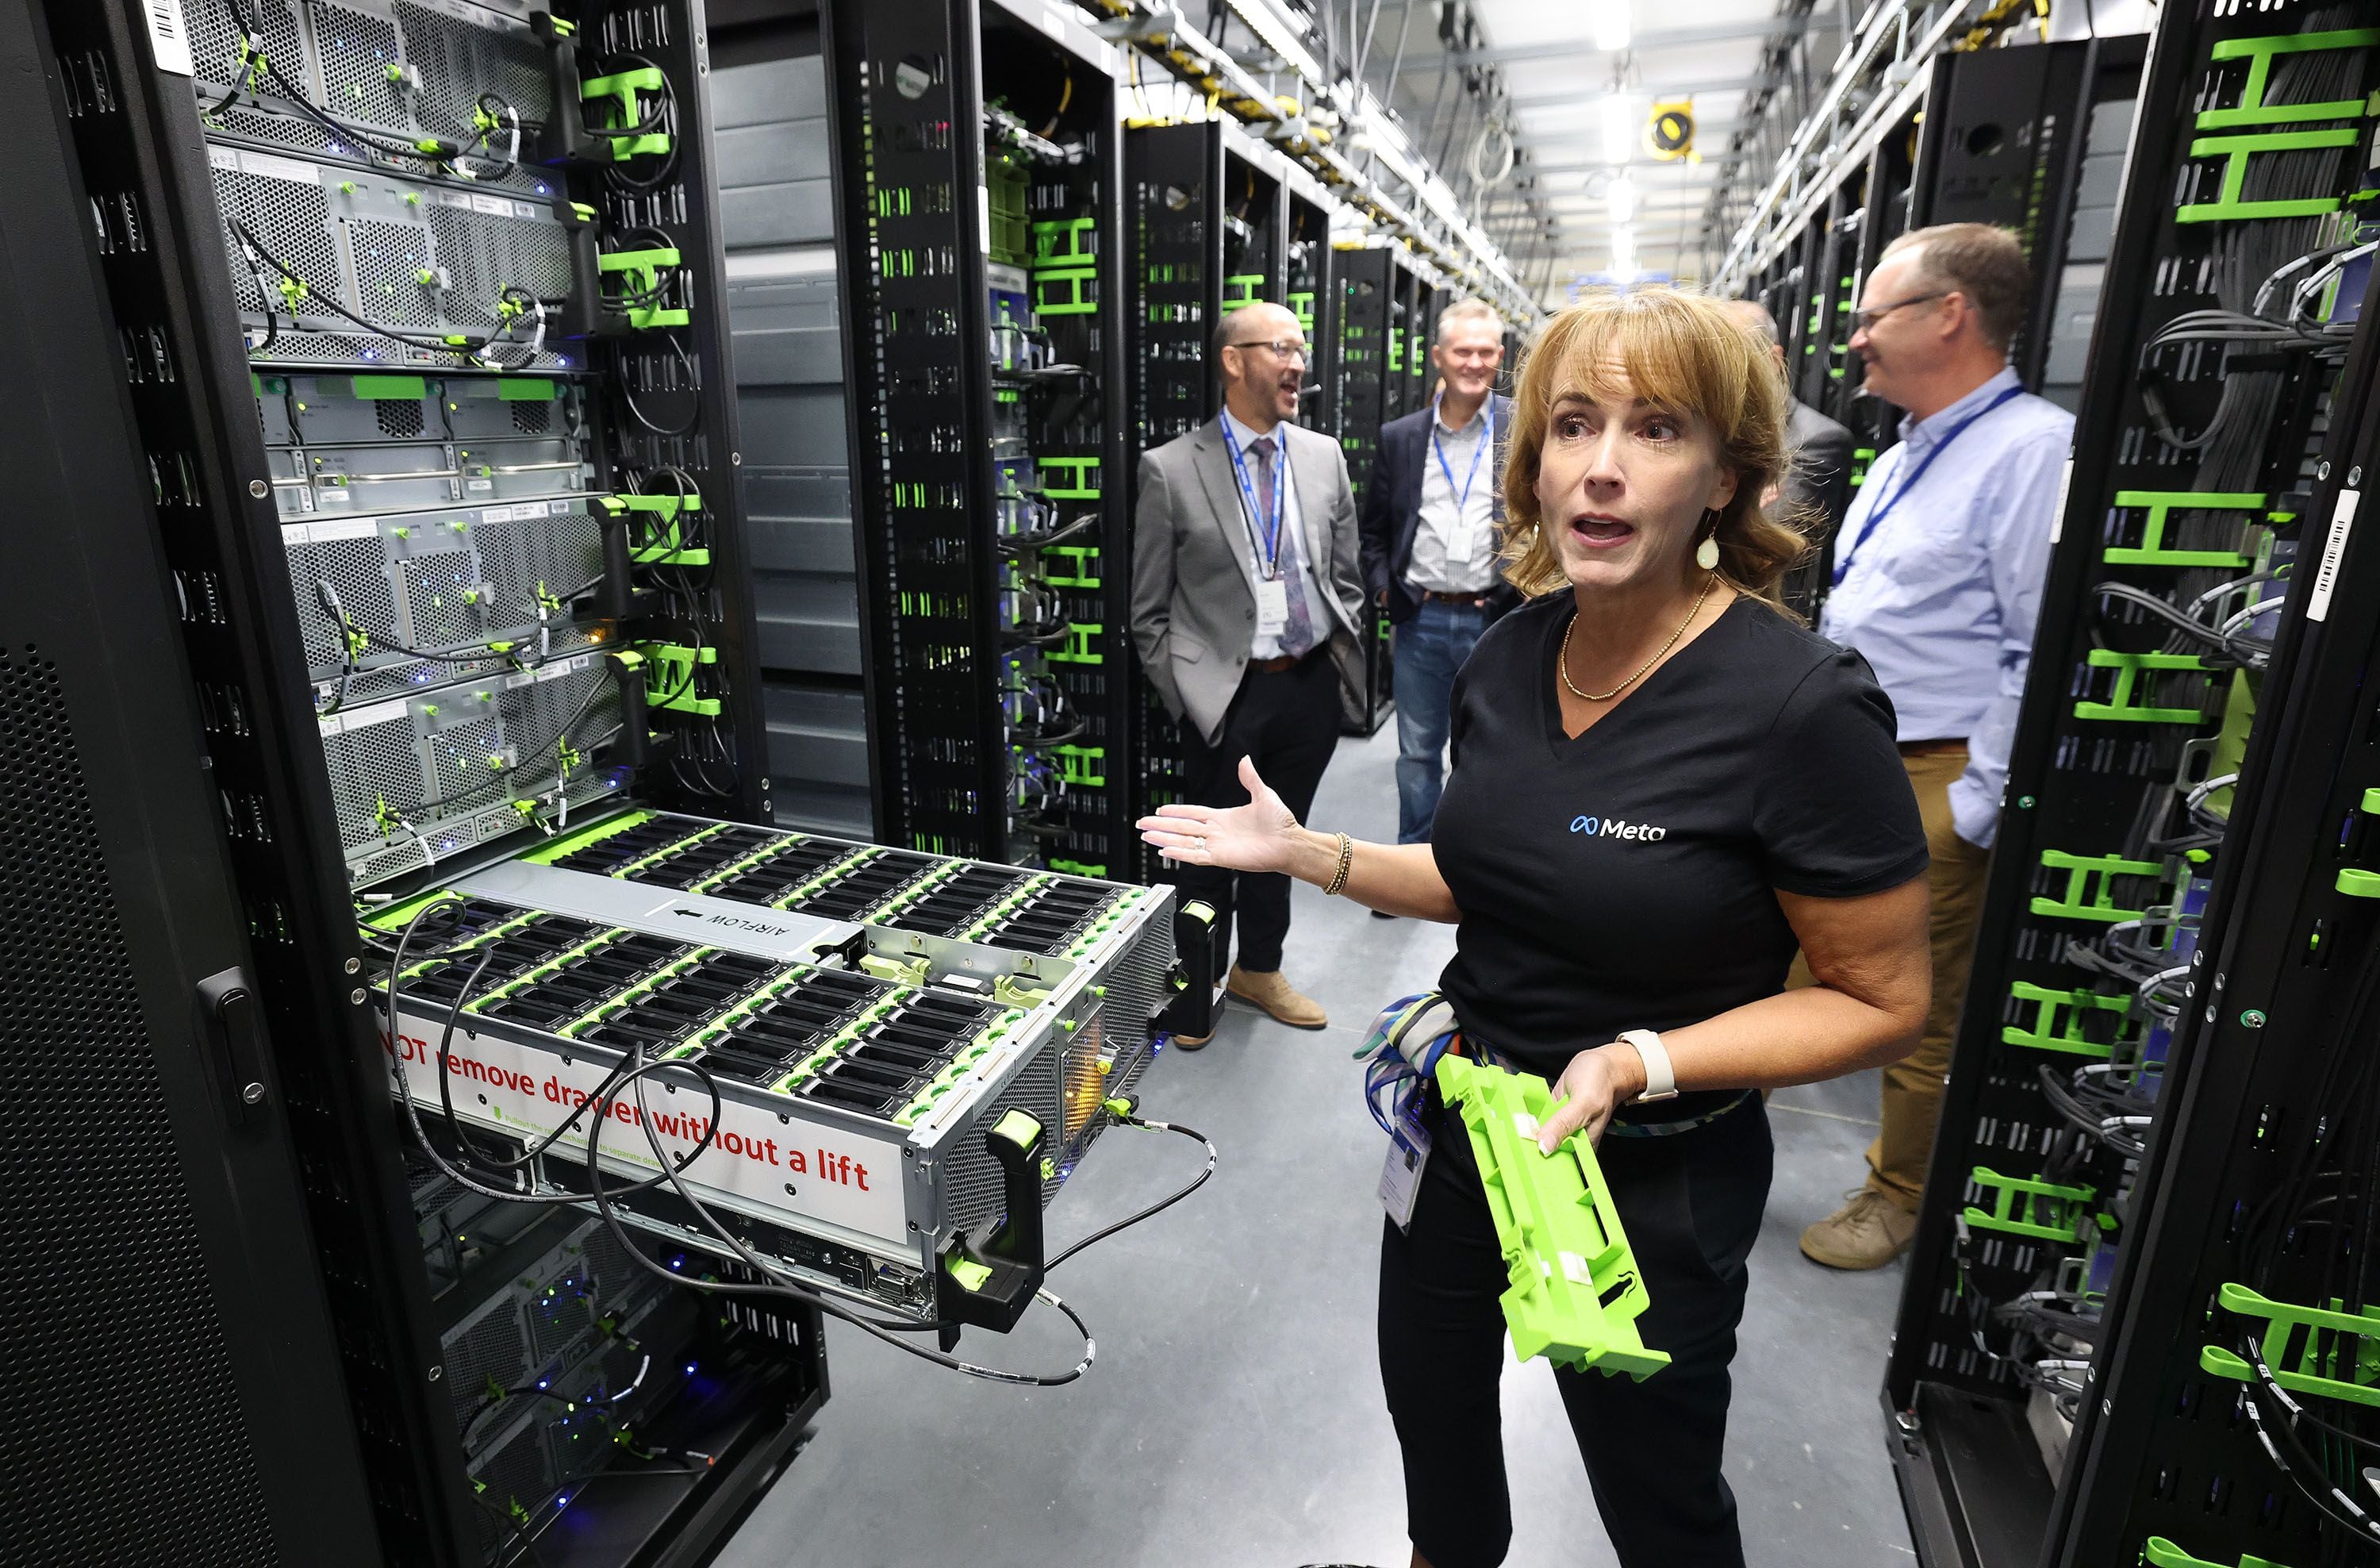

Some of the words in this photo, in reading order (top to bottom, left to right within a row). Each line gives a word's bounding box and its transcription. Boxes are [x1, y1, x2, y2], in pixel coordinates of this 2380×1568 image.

[1599, 818, 1666, 842] Meta
[707, 915, 789, 936] AIRFLOW
[505, 1115, 529, 1128] Pullout
[609, 1147, 641, 1162] separate
[652, 1109, 779, 1166] without
[789, 1149, 808, 1174] a
[817, 1148, 870, 1191] lift
